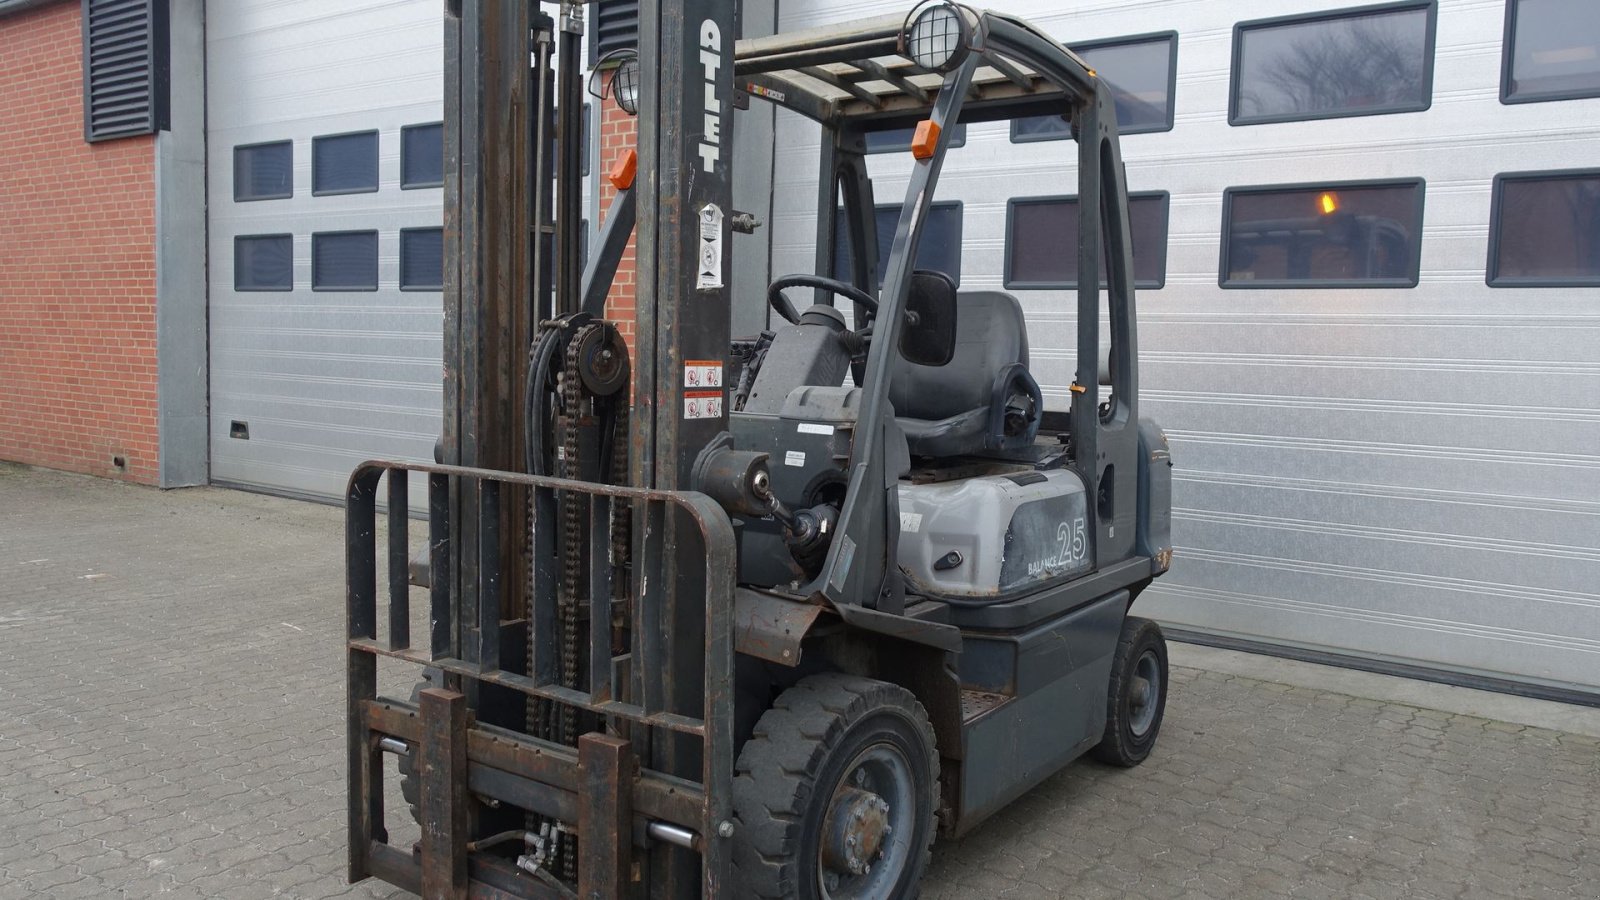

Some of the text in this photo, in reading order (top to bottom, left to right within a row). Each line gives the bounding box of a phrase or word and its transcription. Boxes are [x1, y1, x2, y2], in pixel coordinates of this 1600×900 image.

[699, 18, 721, 174] ATLET
[1028, 517, 1086, 575] BALANCE 25
